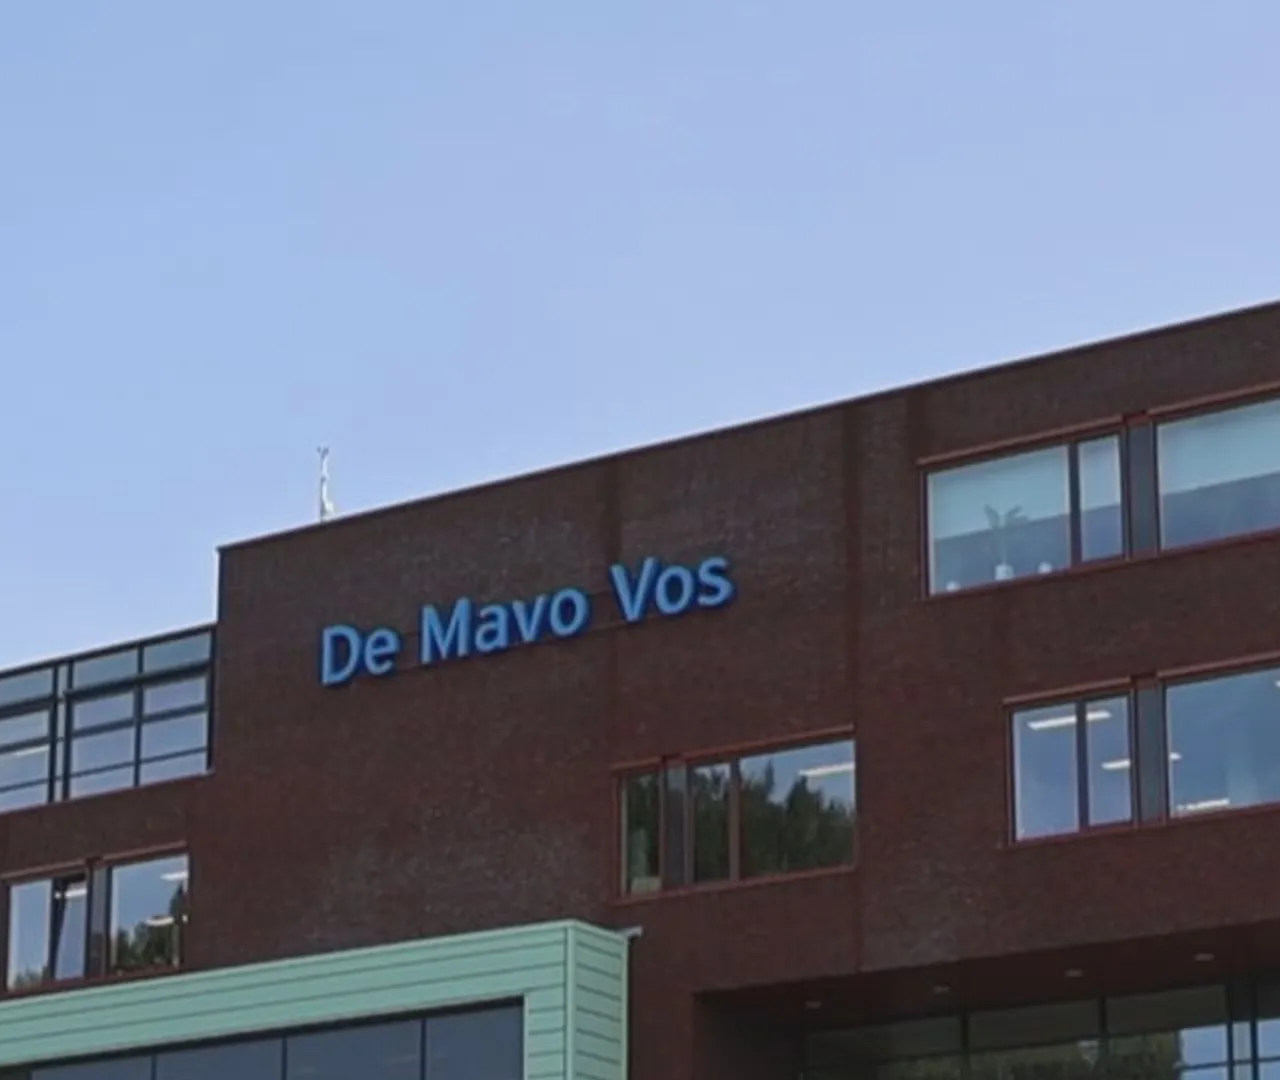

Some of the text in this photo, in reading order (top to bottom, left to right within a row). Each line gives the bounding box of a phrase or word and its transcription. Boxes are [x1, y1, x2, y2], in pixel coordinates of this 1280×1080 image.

[321, 556, 735, 687] De Mavo Vos
